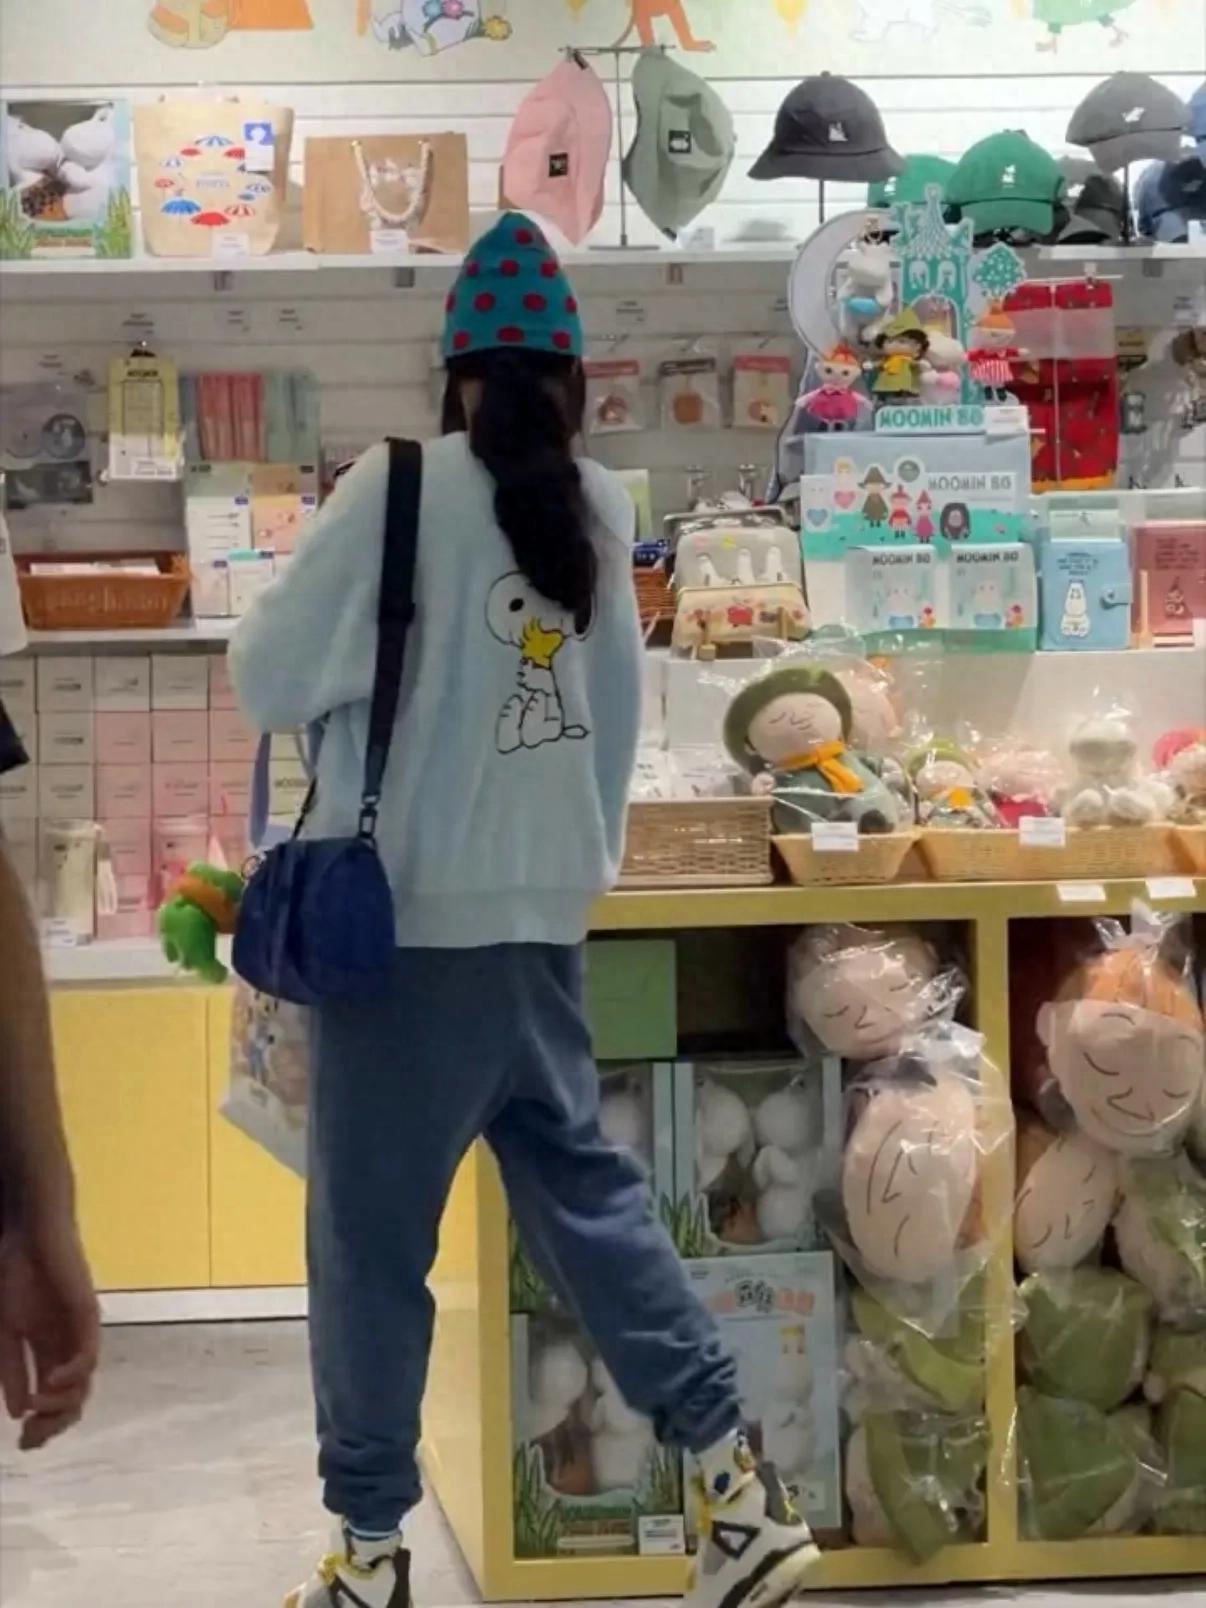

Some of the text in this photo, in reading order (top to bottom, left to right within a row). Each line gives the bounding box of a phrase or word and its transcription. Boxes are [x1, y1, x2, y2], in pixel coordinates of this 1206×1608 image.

[880, 408, 952, 427] MOOMIN
[928, 475, 986, 491] MOOMIN
[872, 552, 913, 565] MOOMIN
[956, 551, 1000, 563] MOOMIN
